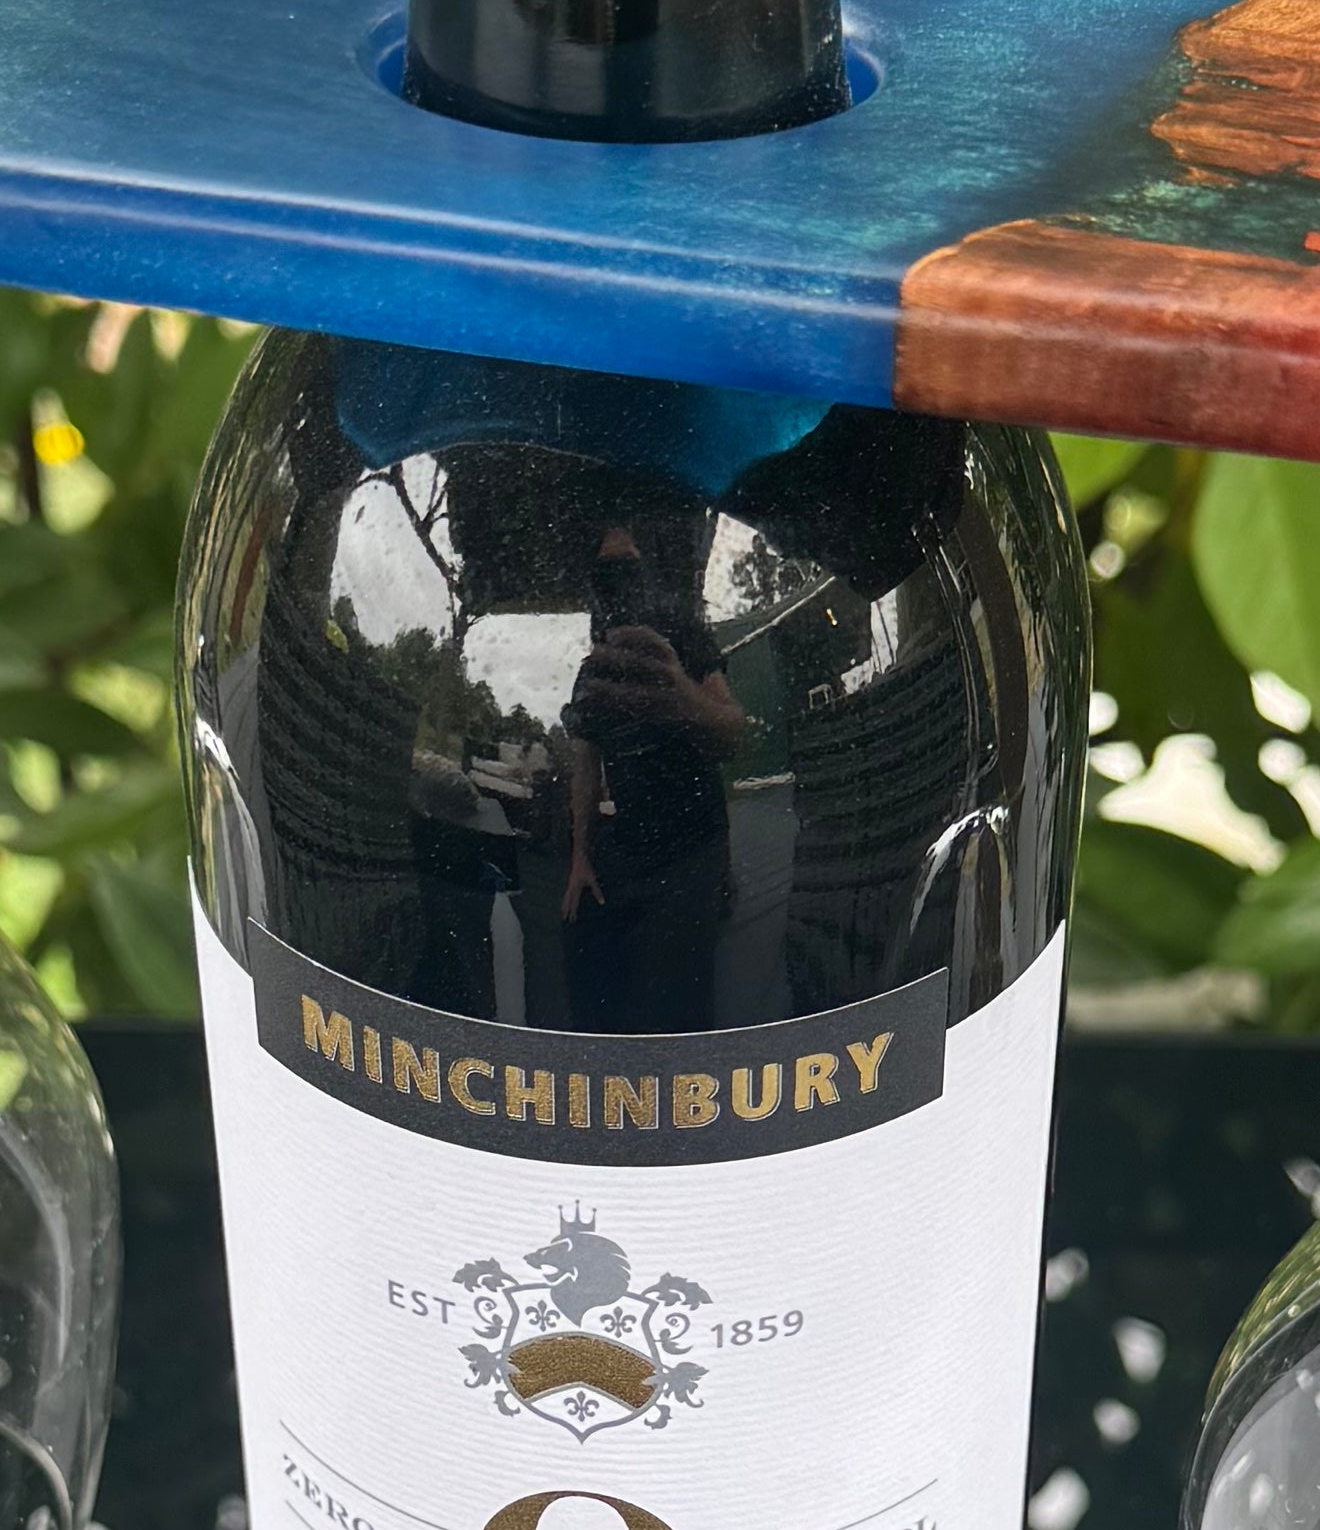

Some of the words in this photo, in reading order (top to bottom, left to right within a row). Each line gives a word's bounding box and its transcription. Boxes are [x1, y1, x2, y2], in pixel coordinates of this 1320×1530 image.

[301, 993, 895, 1130] MINCHINBURY
[387, 1279, 456, 1324] EST
[710, 1309, 805, 1349] 1859
